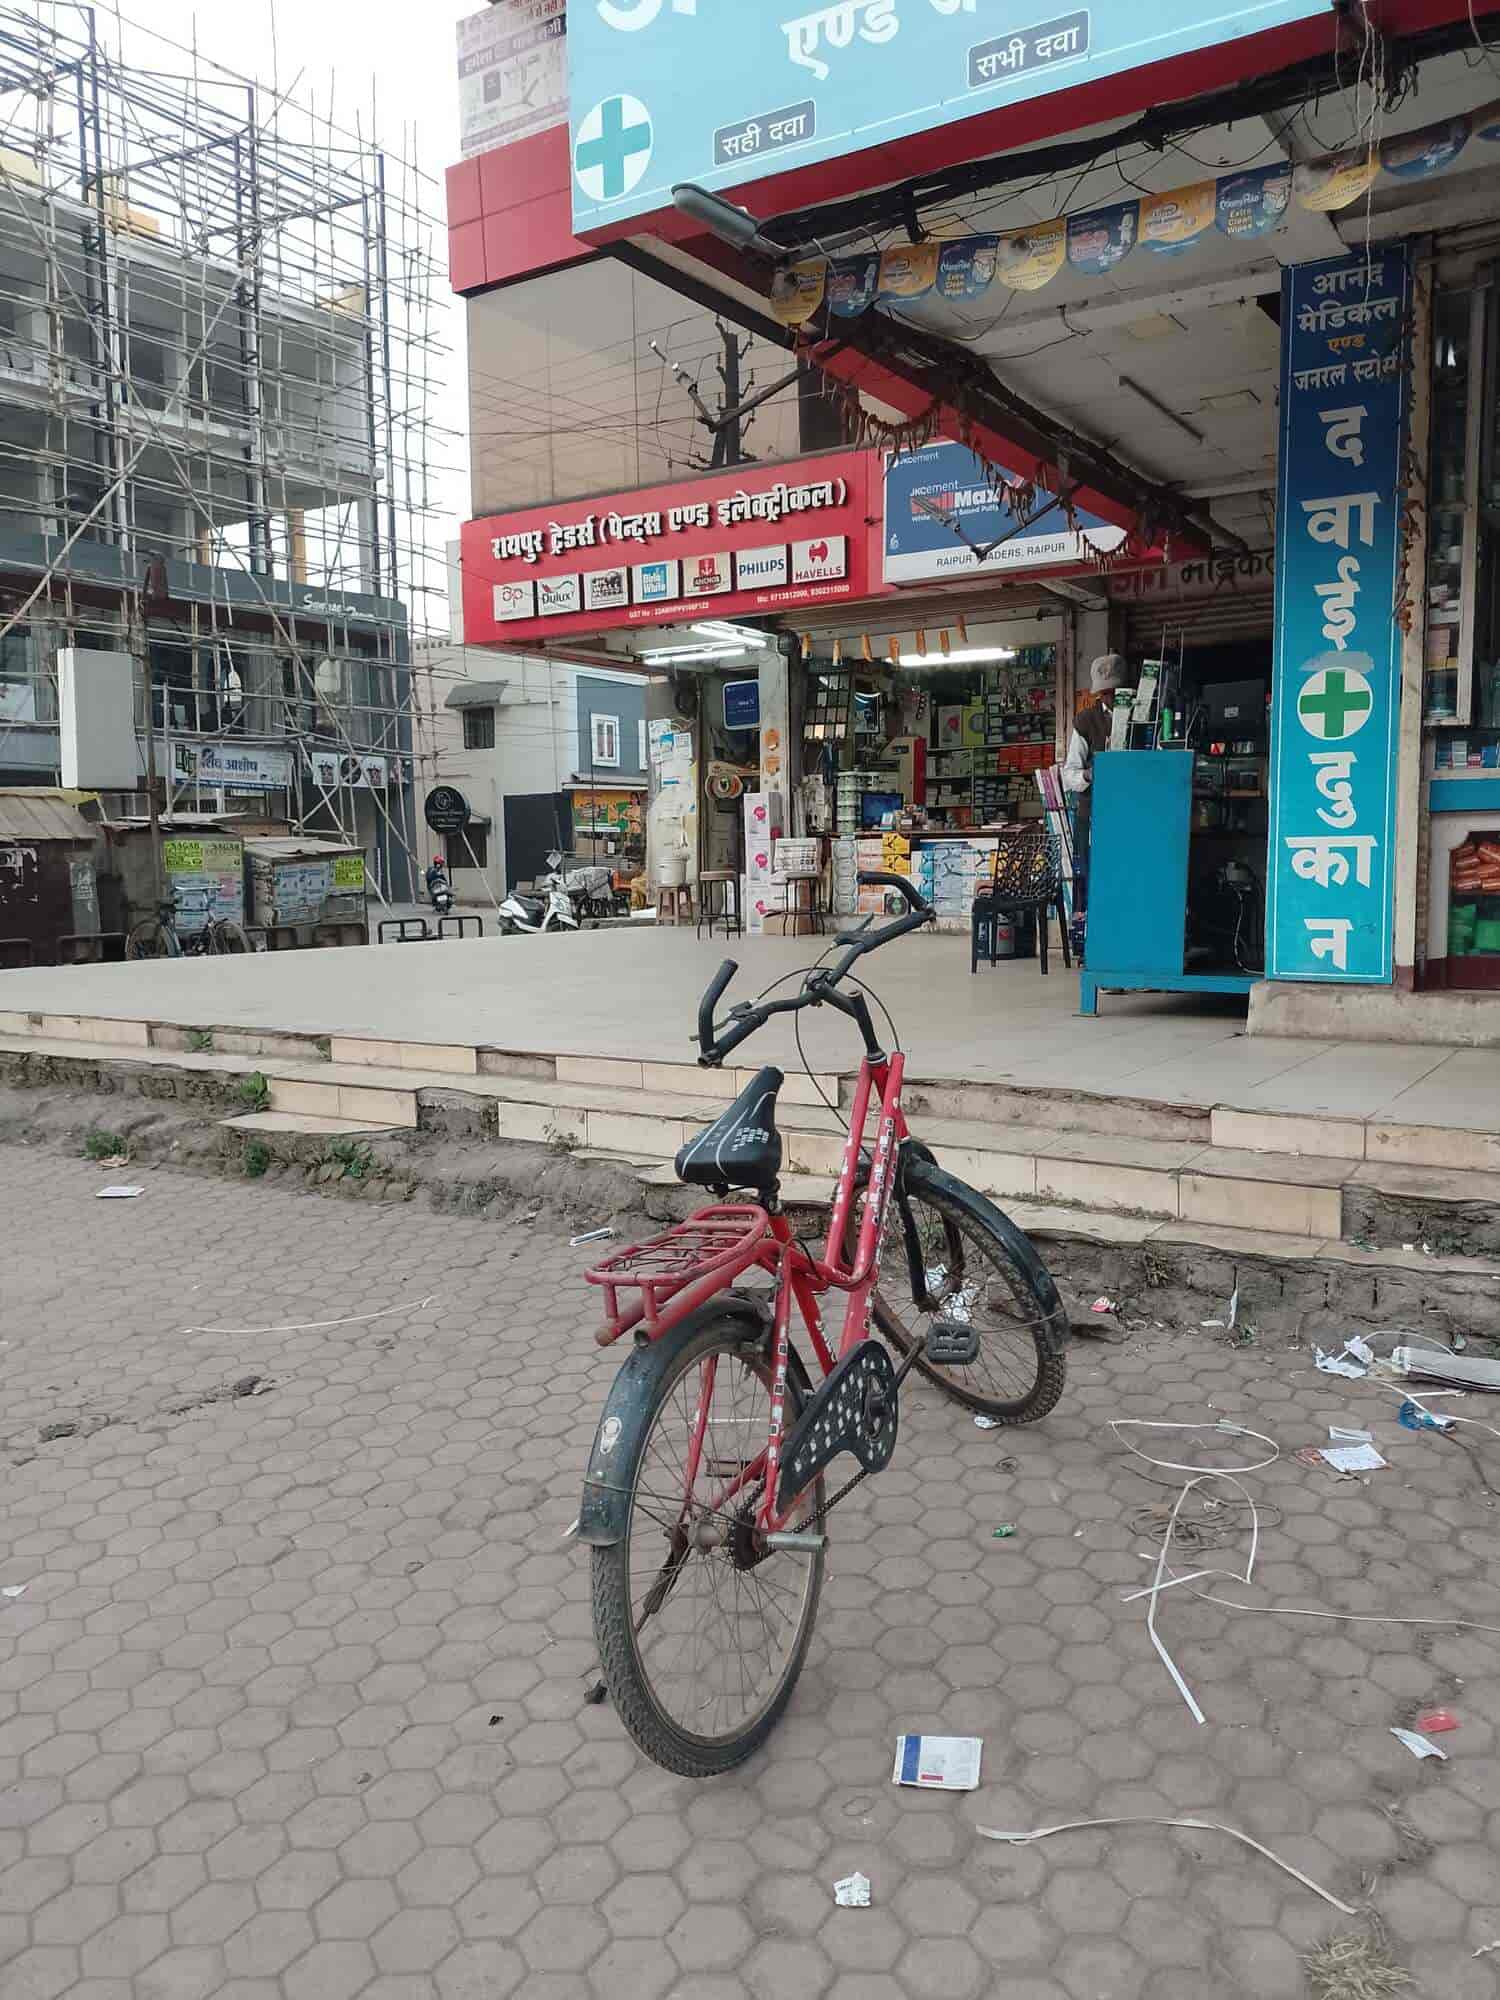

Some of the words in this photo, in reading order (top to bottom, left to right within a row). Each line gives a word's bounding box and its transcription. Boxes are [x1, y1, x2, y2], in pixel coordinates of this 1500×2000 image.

[780, 0, 900, 81] एण्ड
[976, 37, 1026, 78] सभी
[1034, 26, 1080, 58] दवा
[721, 126, 761, 158] सही
[768, 114, 808, 141] दवा
[1311, 258, 1384, 294] आनंद
[1296, 297, 1399, 333] मेडिकल
[1327, 334, 1366, 355] एण्ड
[1293, 363, 1347, 391] जनरल
[490, 530, 544, 563] रायपुर
[548, 515, 596, 555] ट्रेडर्स
[667, 502, 710, 531] एण्ड
[738, 558, 785, 577] PHILIPS
[936, 554, 973, 568] RAIPUR
[1027, 542, 1066, 557] RAIPUR
[795, 565, 842, 582] HAVELLS
[542, 591, 571, 605] Dulux
[1285, 751, 1379, 971] दुकान
